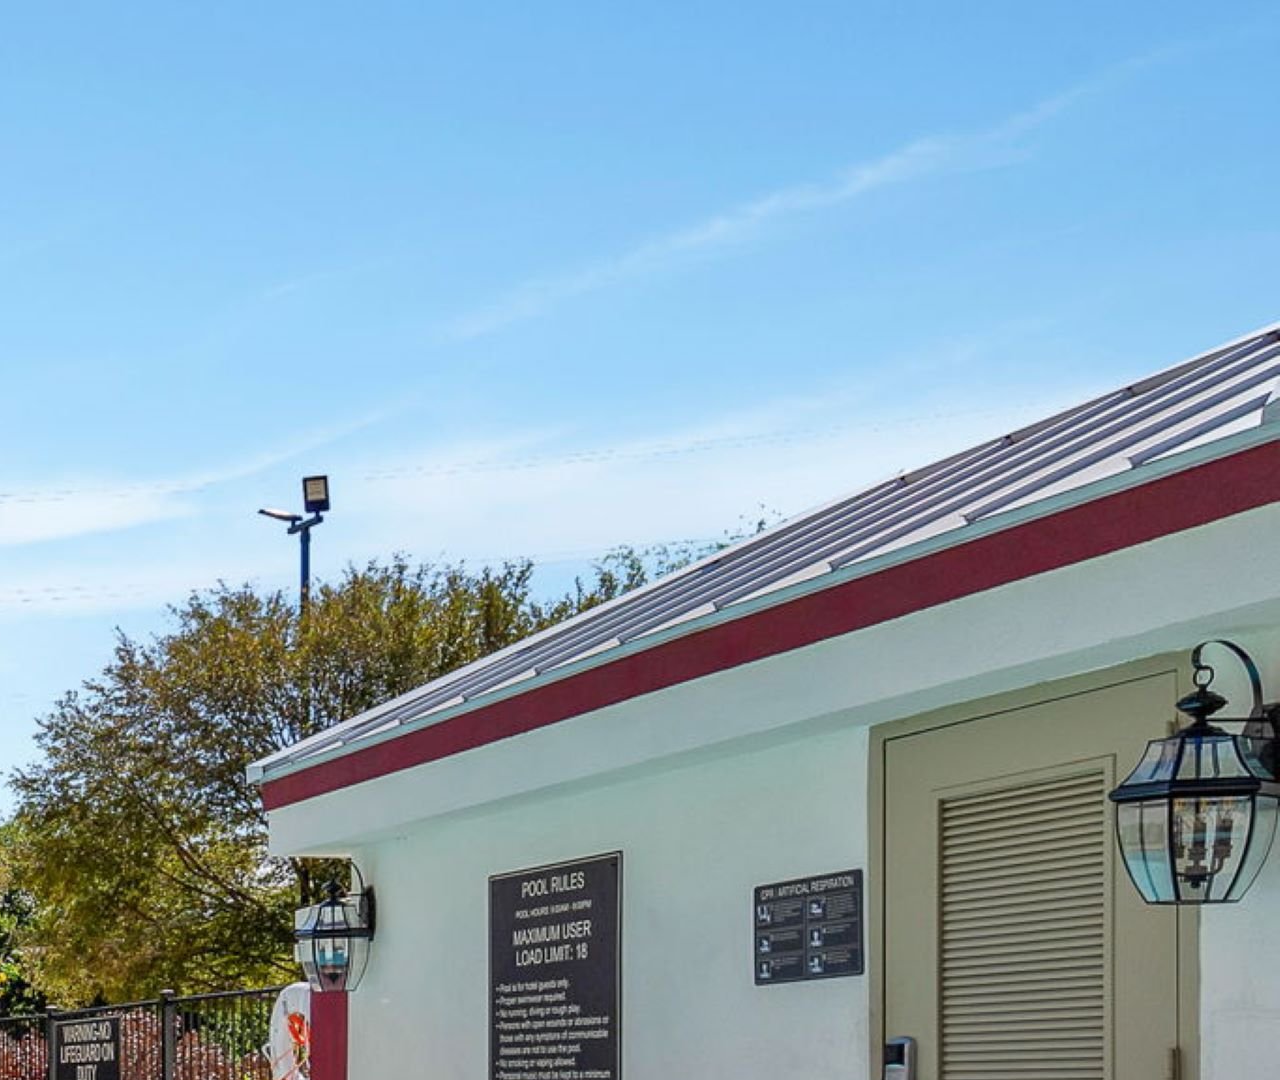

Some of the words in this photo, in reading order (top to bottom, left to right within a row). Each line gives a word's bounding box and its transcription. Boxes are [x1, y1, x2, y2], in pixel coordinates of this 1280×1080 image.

[521, 878, 548, 898] POOL
[551, 871, 585, 893] RULES
[512, 923, 560, 945] MAXIMUM
[562, 920, 592, 939] USER
[516, 947, 543, 966] LOAD
[544, 944, 573, 963] LIMIT:
[60, 1045, 101, 1063] LIFEGUARD
[102, 1042, 115, 1061] ON
